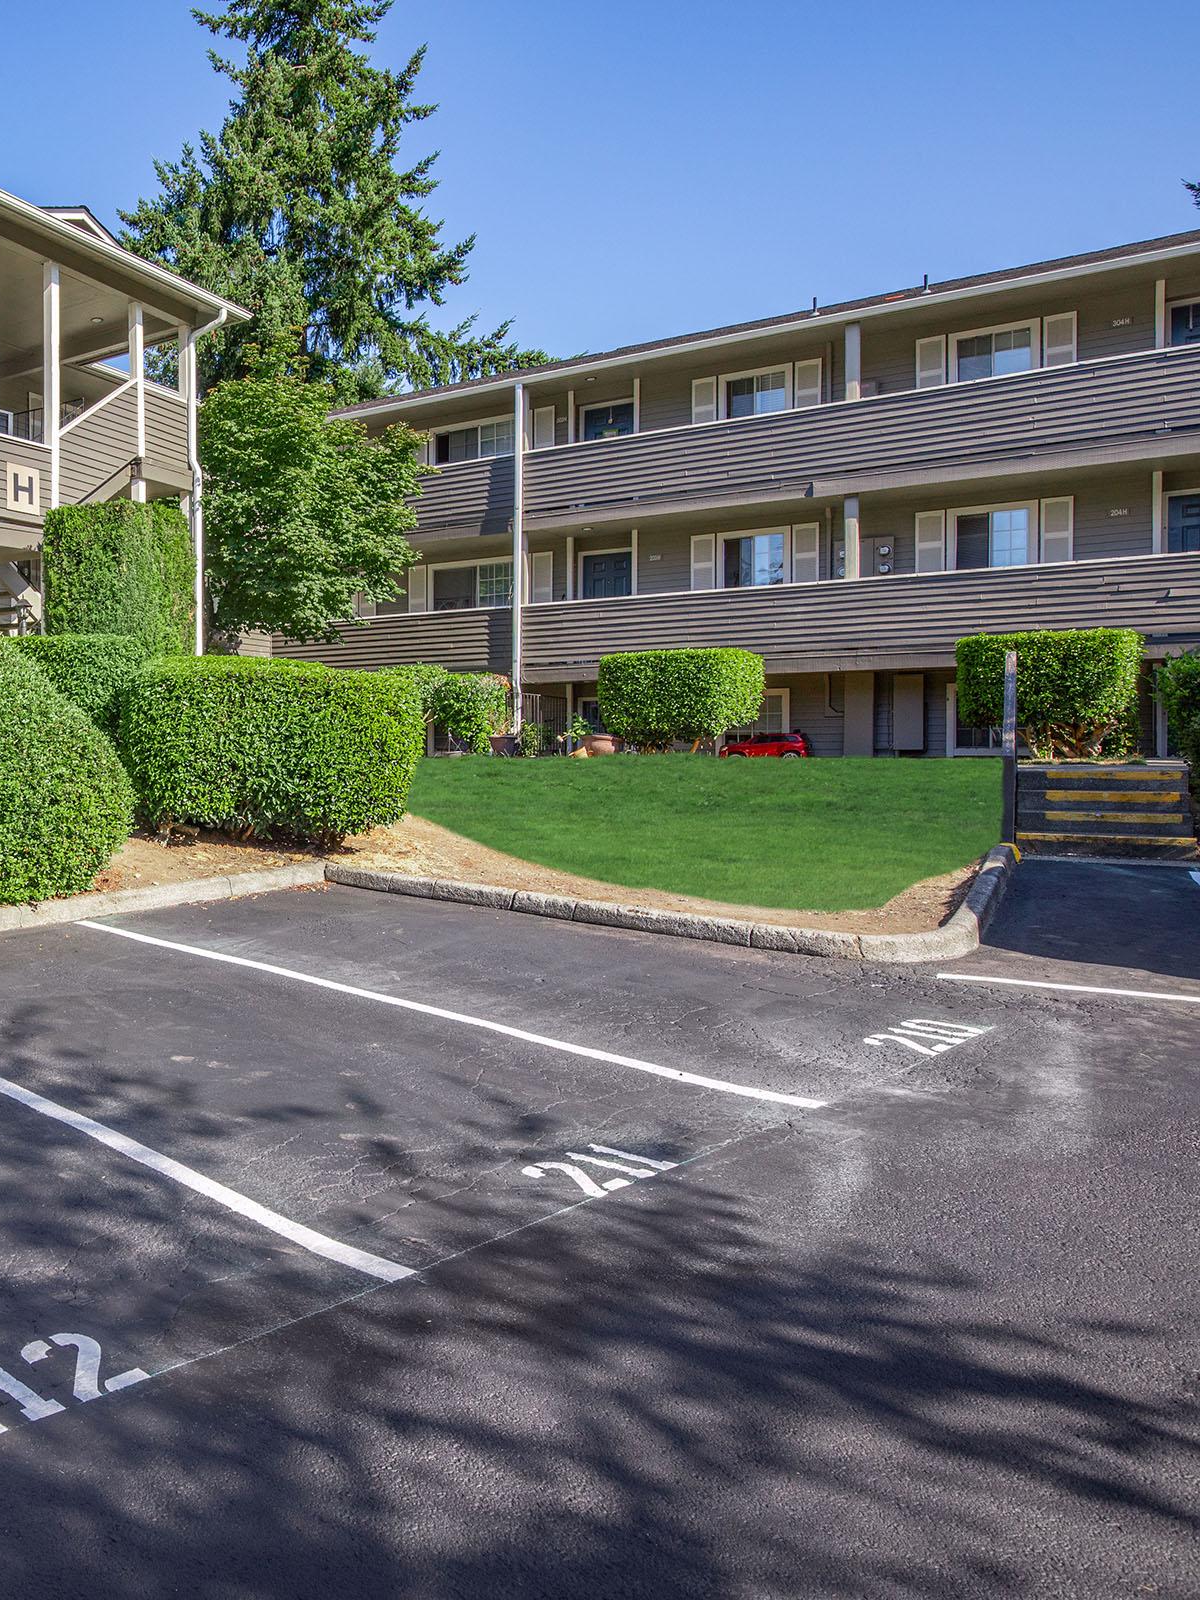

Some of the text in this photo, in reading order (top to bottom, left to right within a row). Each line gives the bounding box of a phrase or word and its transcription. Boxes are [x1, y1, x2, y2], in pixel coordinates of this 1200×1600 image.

[13, 472, 33, 505] H
[863, 1019, 985, 1056] 210
[522, 1143, 679, 1198] 211
